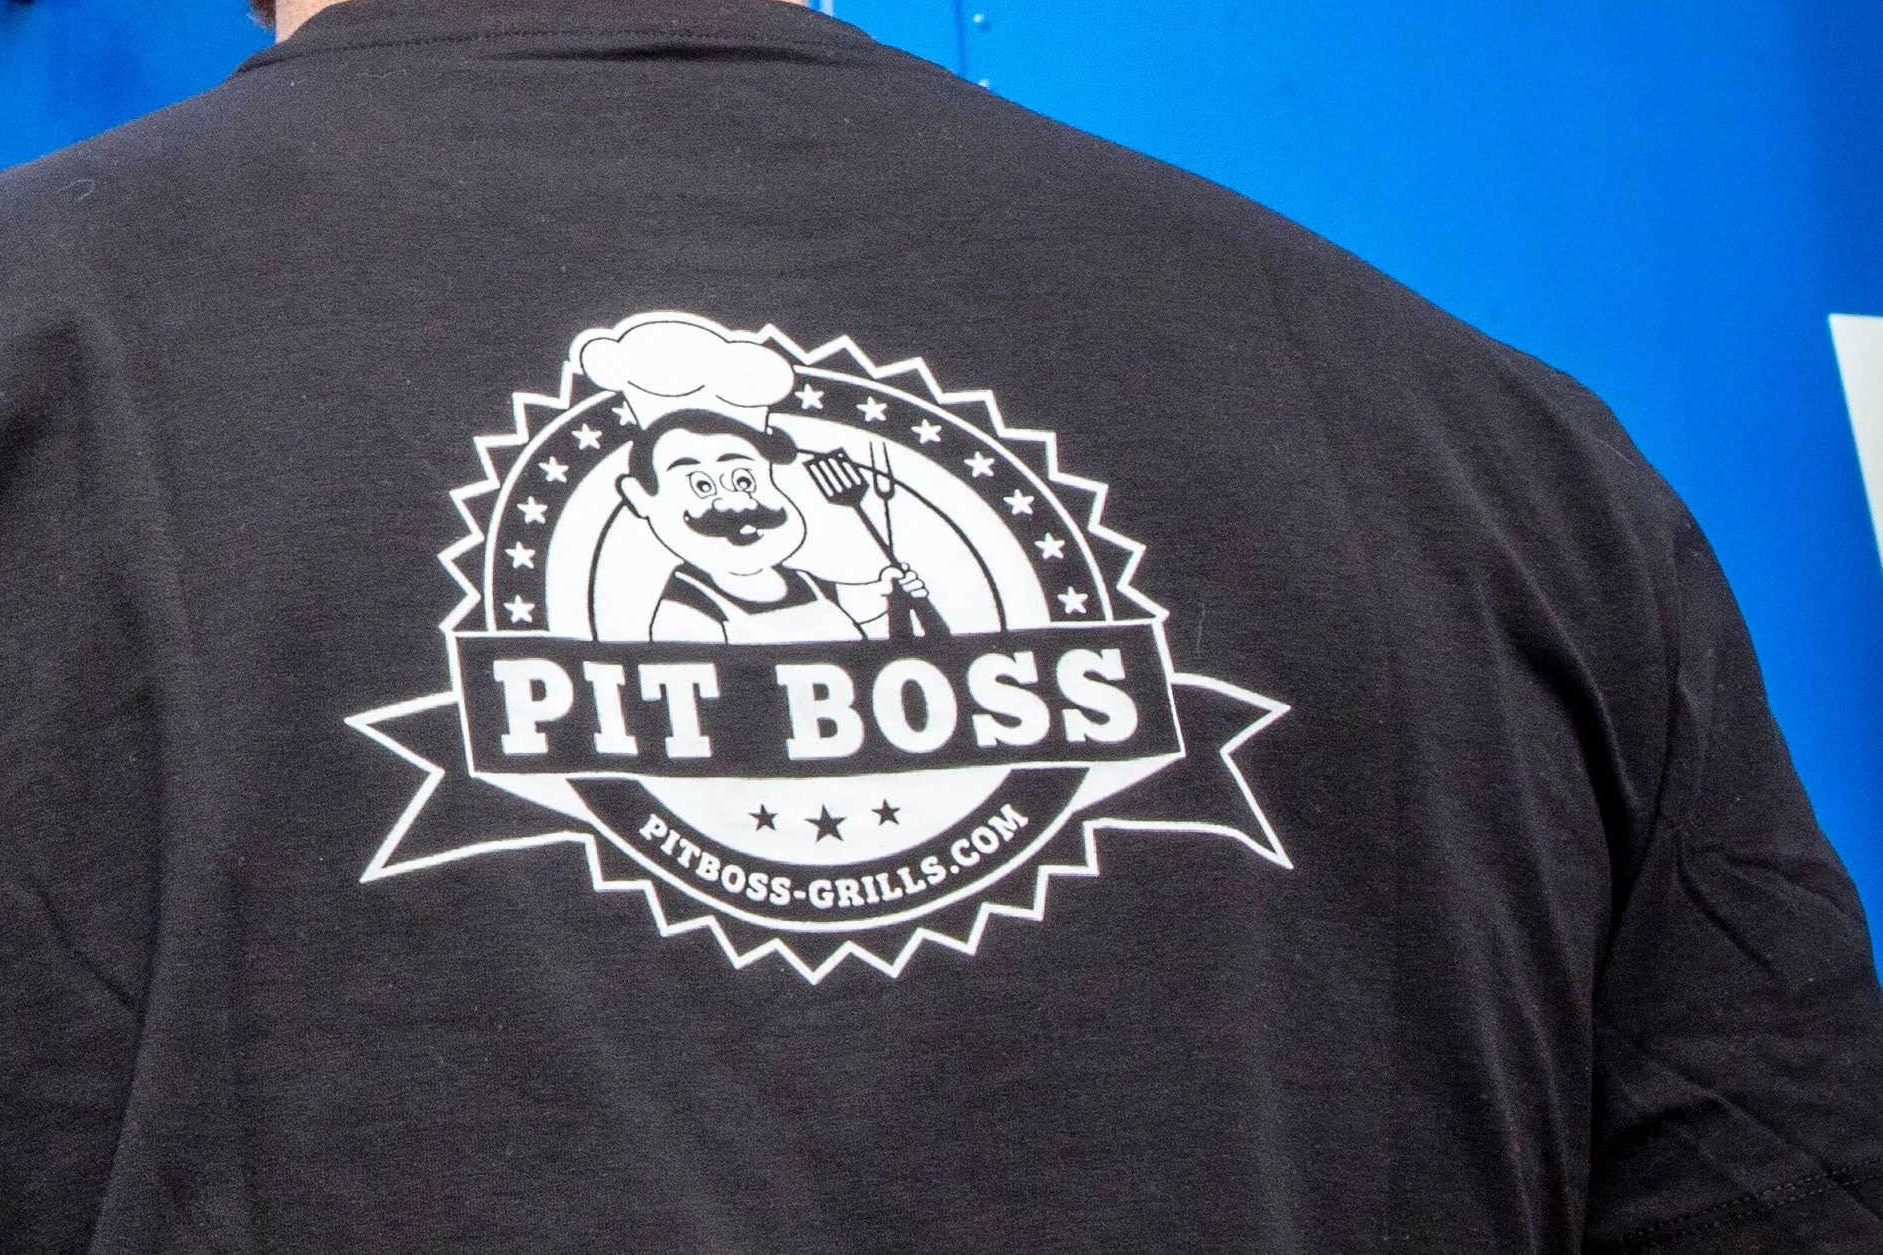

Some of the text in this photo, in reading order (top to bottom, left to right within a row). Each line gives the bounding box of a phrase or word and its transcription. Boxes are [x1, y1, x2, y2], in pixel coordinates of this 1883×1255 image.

[494, 649, 1139, 760] PIT BOSS
[638, 803, 1030, 909] PITBOSS-GRILLS.COM
